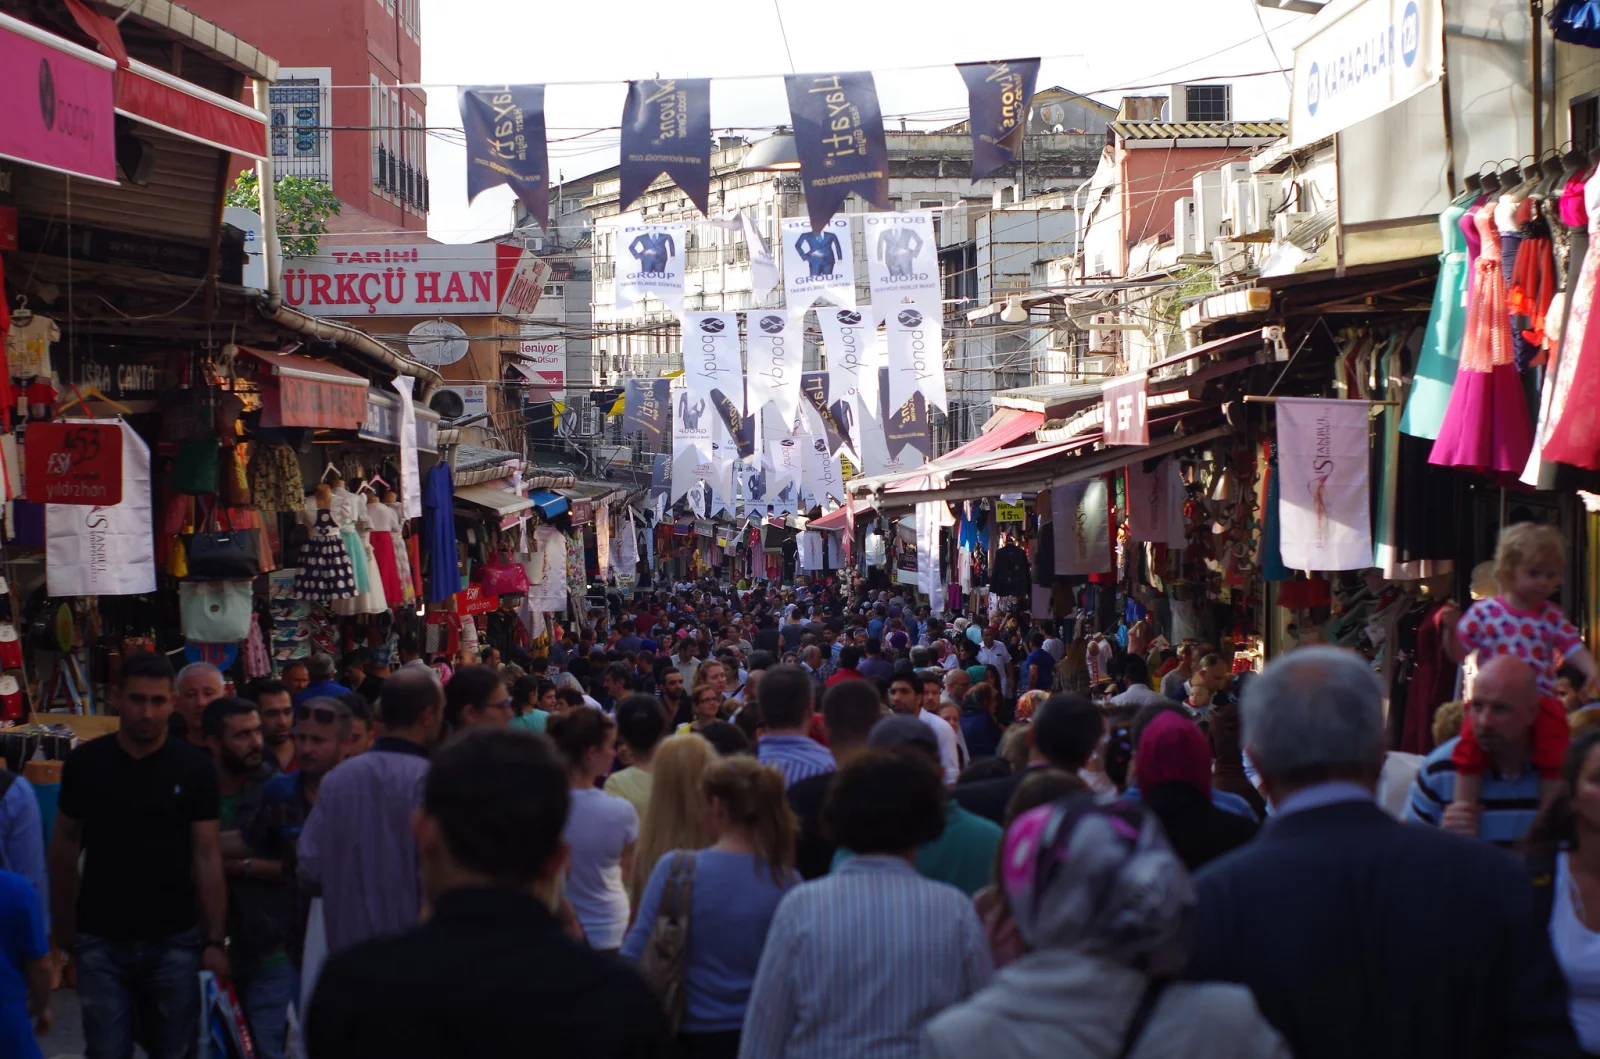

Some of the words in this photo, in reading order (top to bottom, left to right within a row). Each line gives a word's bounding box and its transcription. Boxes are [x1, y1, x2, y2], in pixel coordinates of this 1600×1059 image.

[788, 220, 848, 230] BOTO
[331, 248, 419, 264] TARİHİ
[281, 267, 407, 314] ÜRKÇÜ
[415, 271, 493, 304] HAN
[626, 271, 676, 280] GROUP
[795, 274, 844, 286] GROUP
[697, 335, 731, 381] bondy
[839, 326, 869, 376] bondy
[86, 514, 108, 572] ISTANBUL
